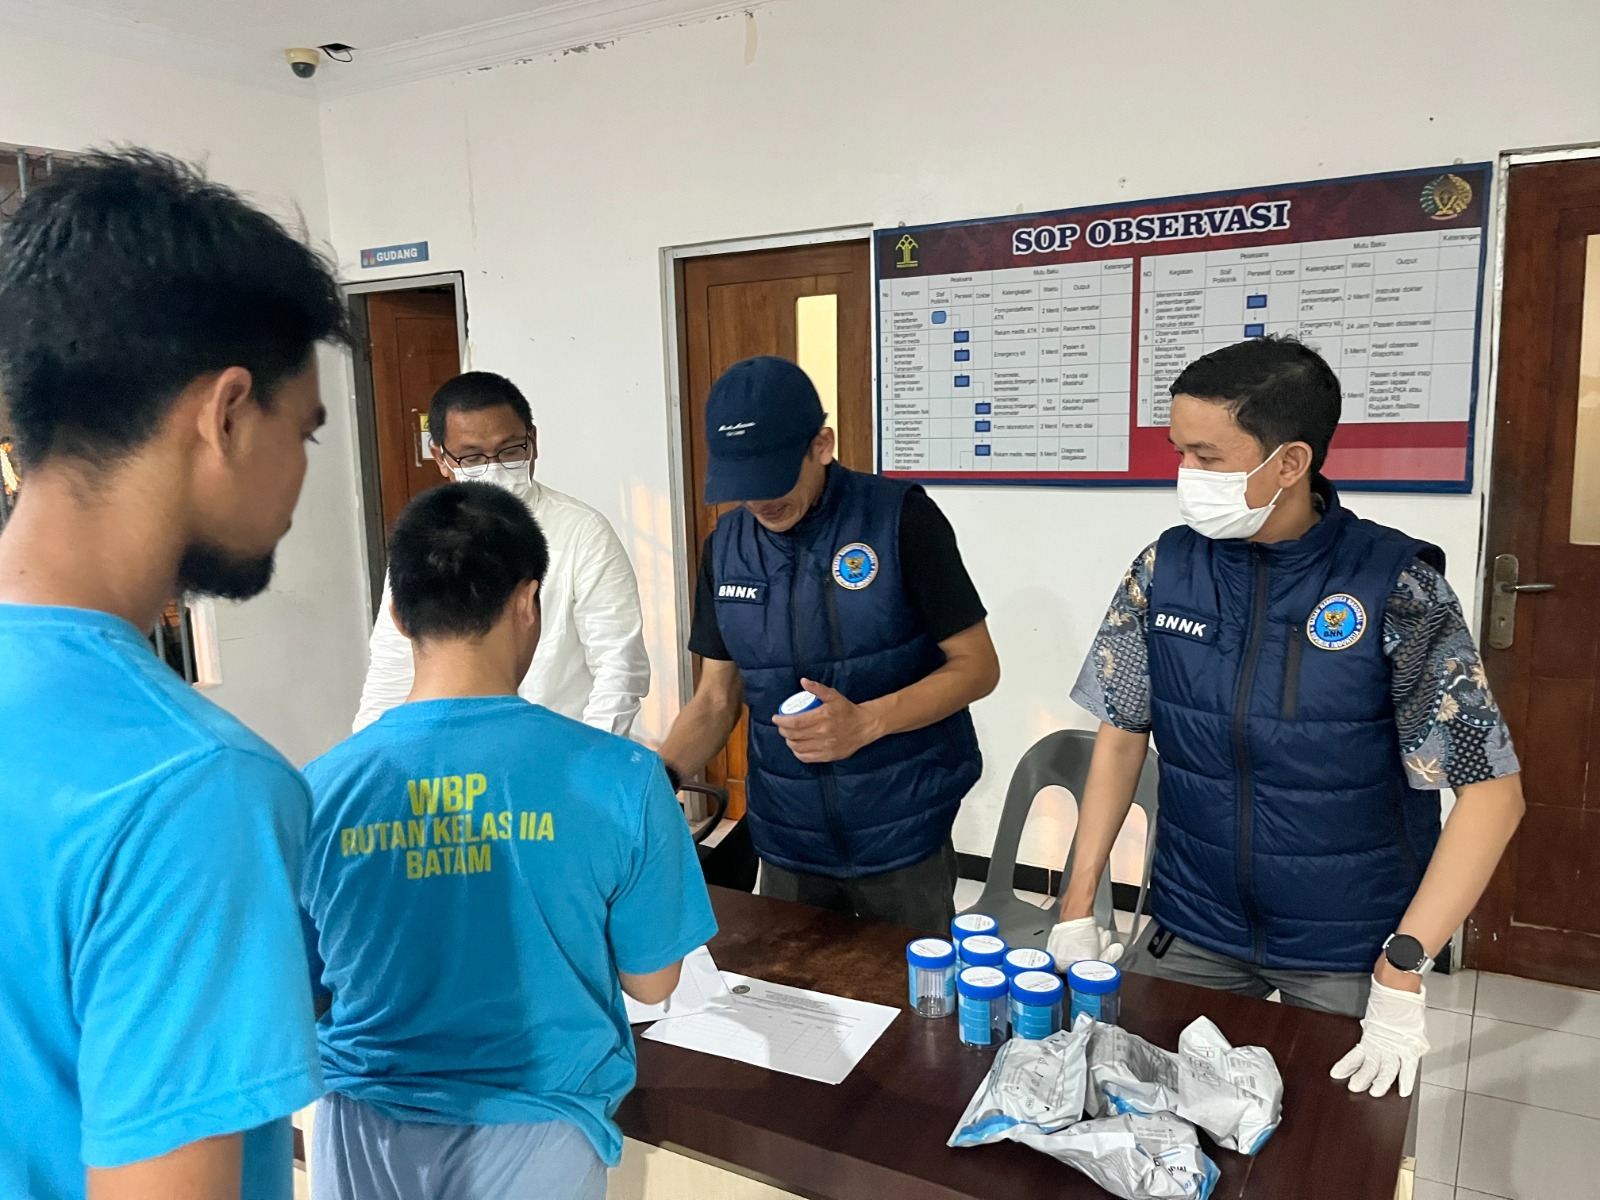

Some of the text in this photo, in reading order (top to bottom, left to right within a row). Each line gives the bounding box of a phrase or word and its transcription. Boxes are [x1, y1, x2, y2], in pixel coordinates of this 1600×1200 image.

[1013, 202, 1290, 254] SOP OBSERVASI
[376, 248, 418, 262] GUDANG
[718, 585, 758, 599] BNNK
[1155, 613, 1207, 637] BNNK
[407, 773, 487, 816] WBP
[341, 811, 555, 857] RUTAN KELAS IIA
[406, 844, 492, 879] BATAM
